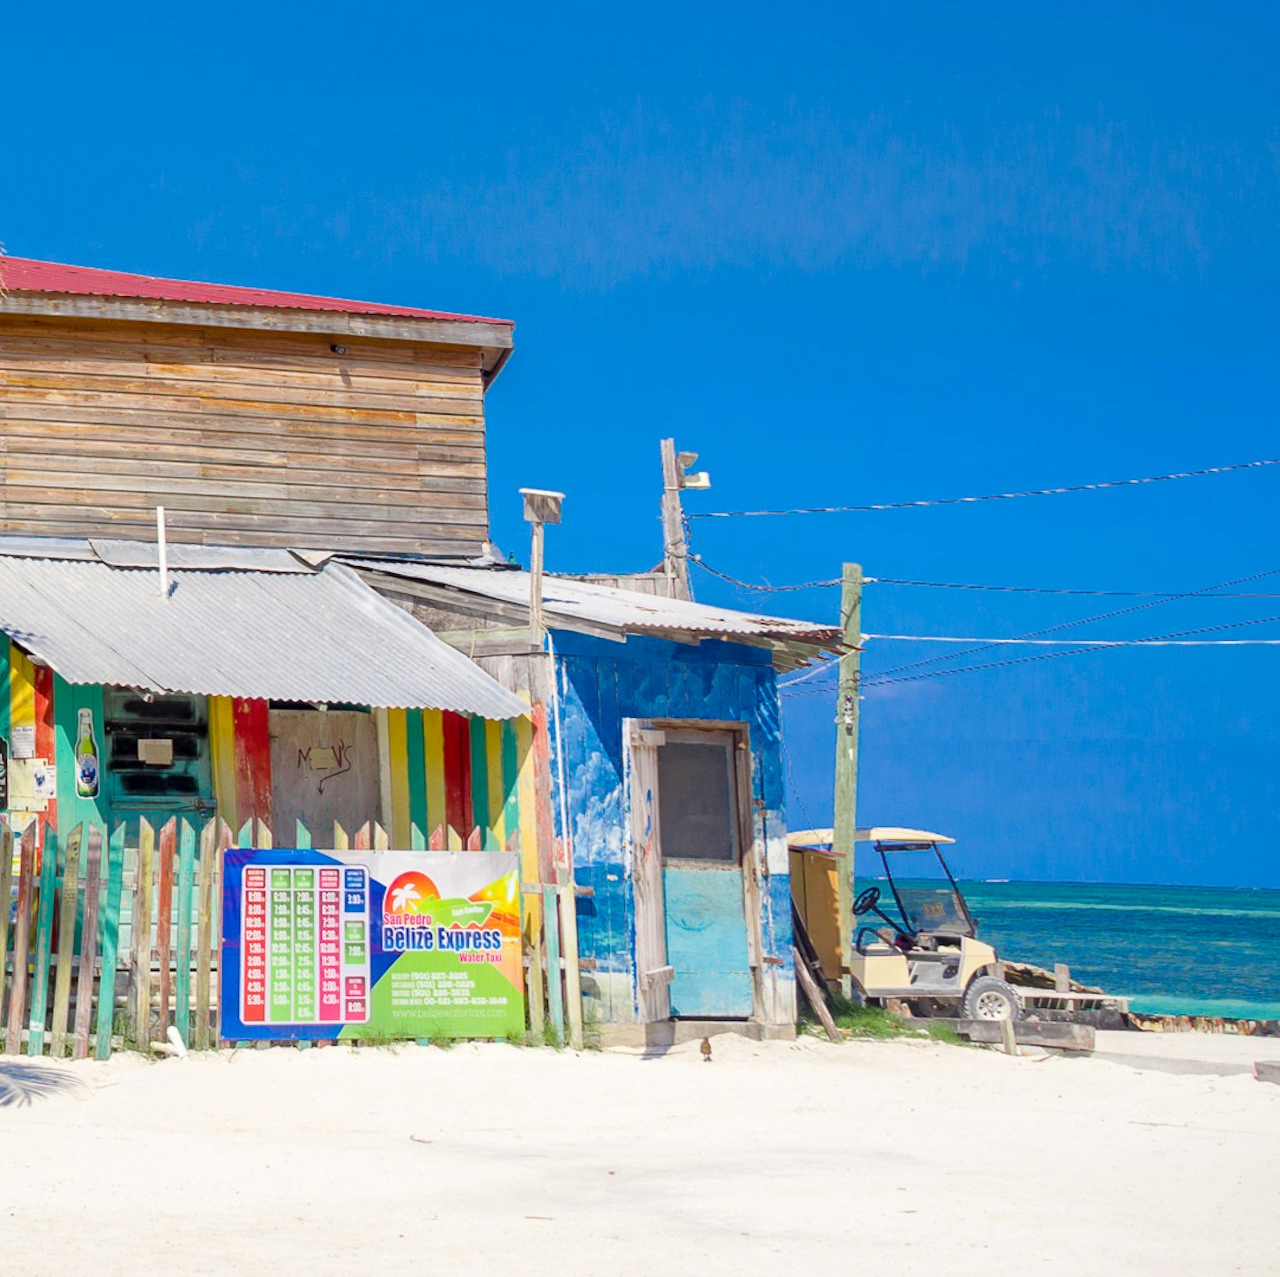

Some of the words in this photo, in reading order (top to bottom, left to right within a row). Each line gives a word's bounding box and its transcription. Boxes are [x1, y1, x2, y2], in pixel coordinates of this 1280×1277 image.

[384, 913, 402, 924] San
[404, 913, 432, 924] Pedro
[384, 927, 433, 949] Belize
[438, 928, 501, 951] Express
[460, 953, 483, 962] Water
[486, 953, 501, 962] Taxi
